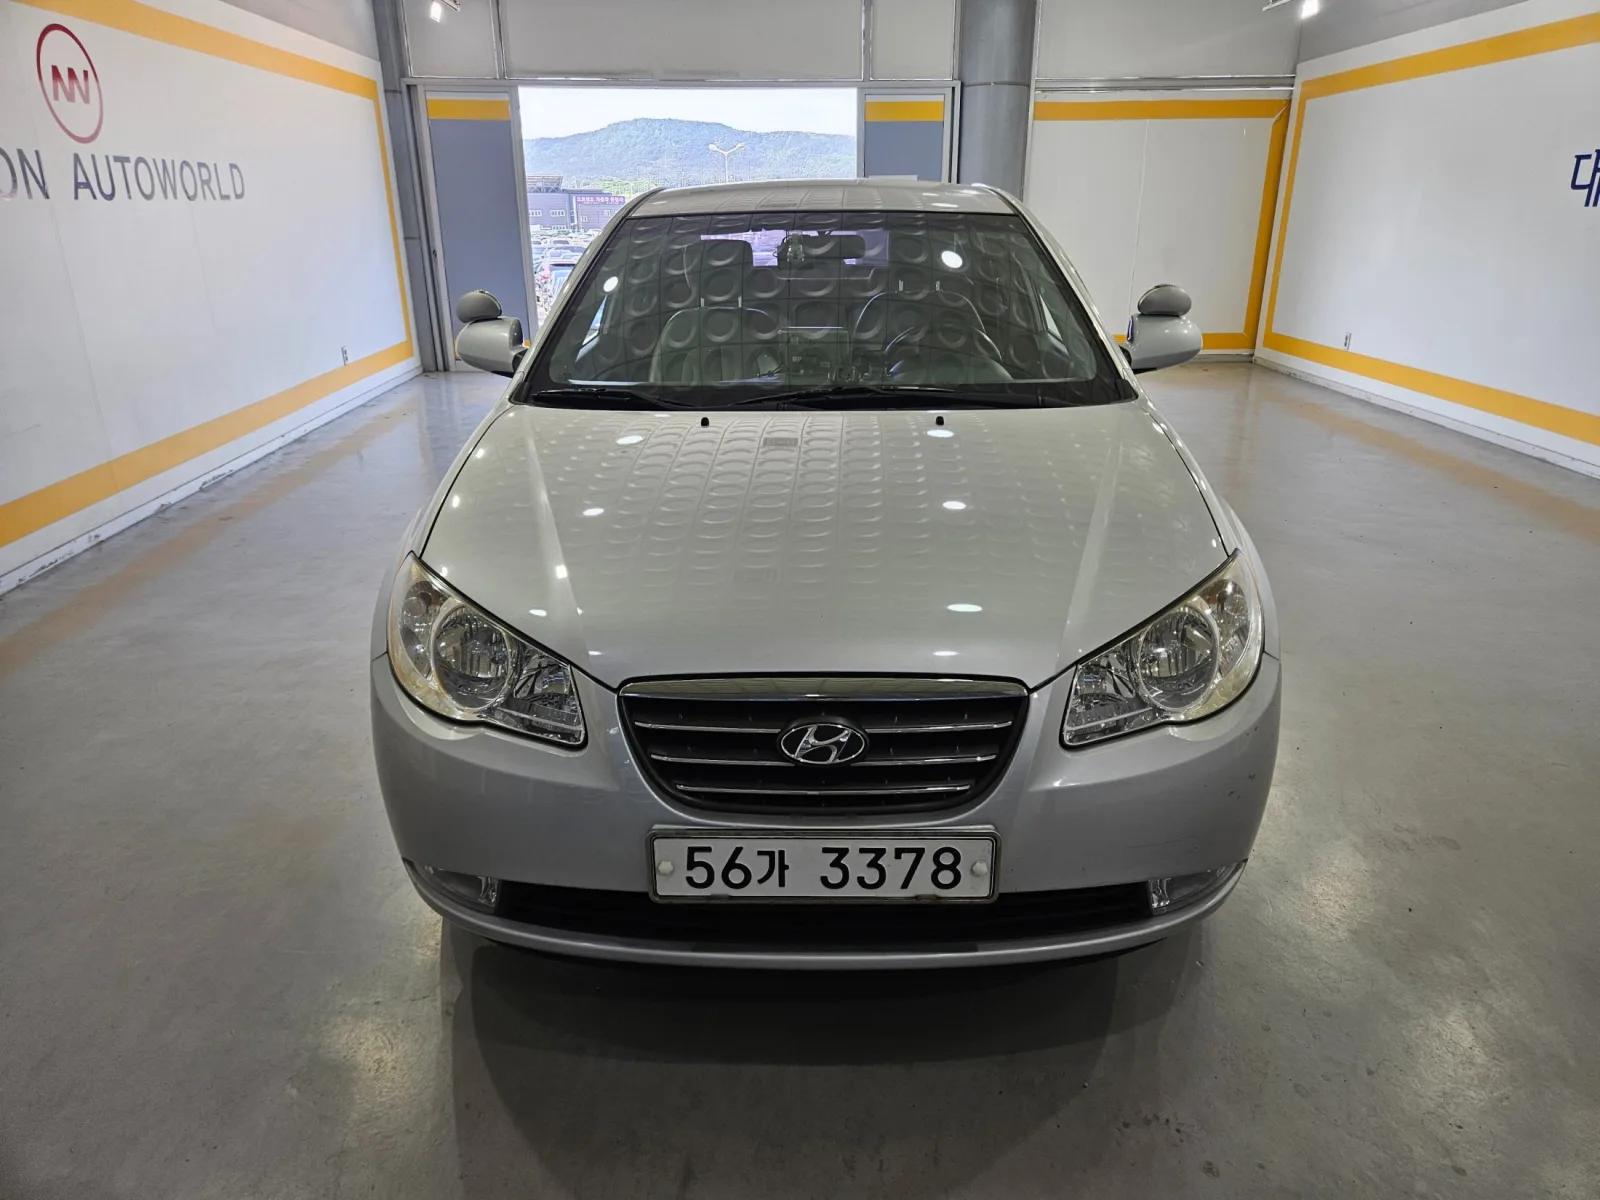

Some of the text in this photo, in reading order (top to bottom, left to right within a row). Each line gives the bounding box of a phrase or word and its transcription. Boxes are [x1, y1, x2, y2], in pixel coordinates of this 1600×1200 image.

[73, 152, 246, 202] AUTOWORLD
[685, 845, 962, 890] 56가 3378
